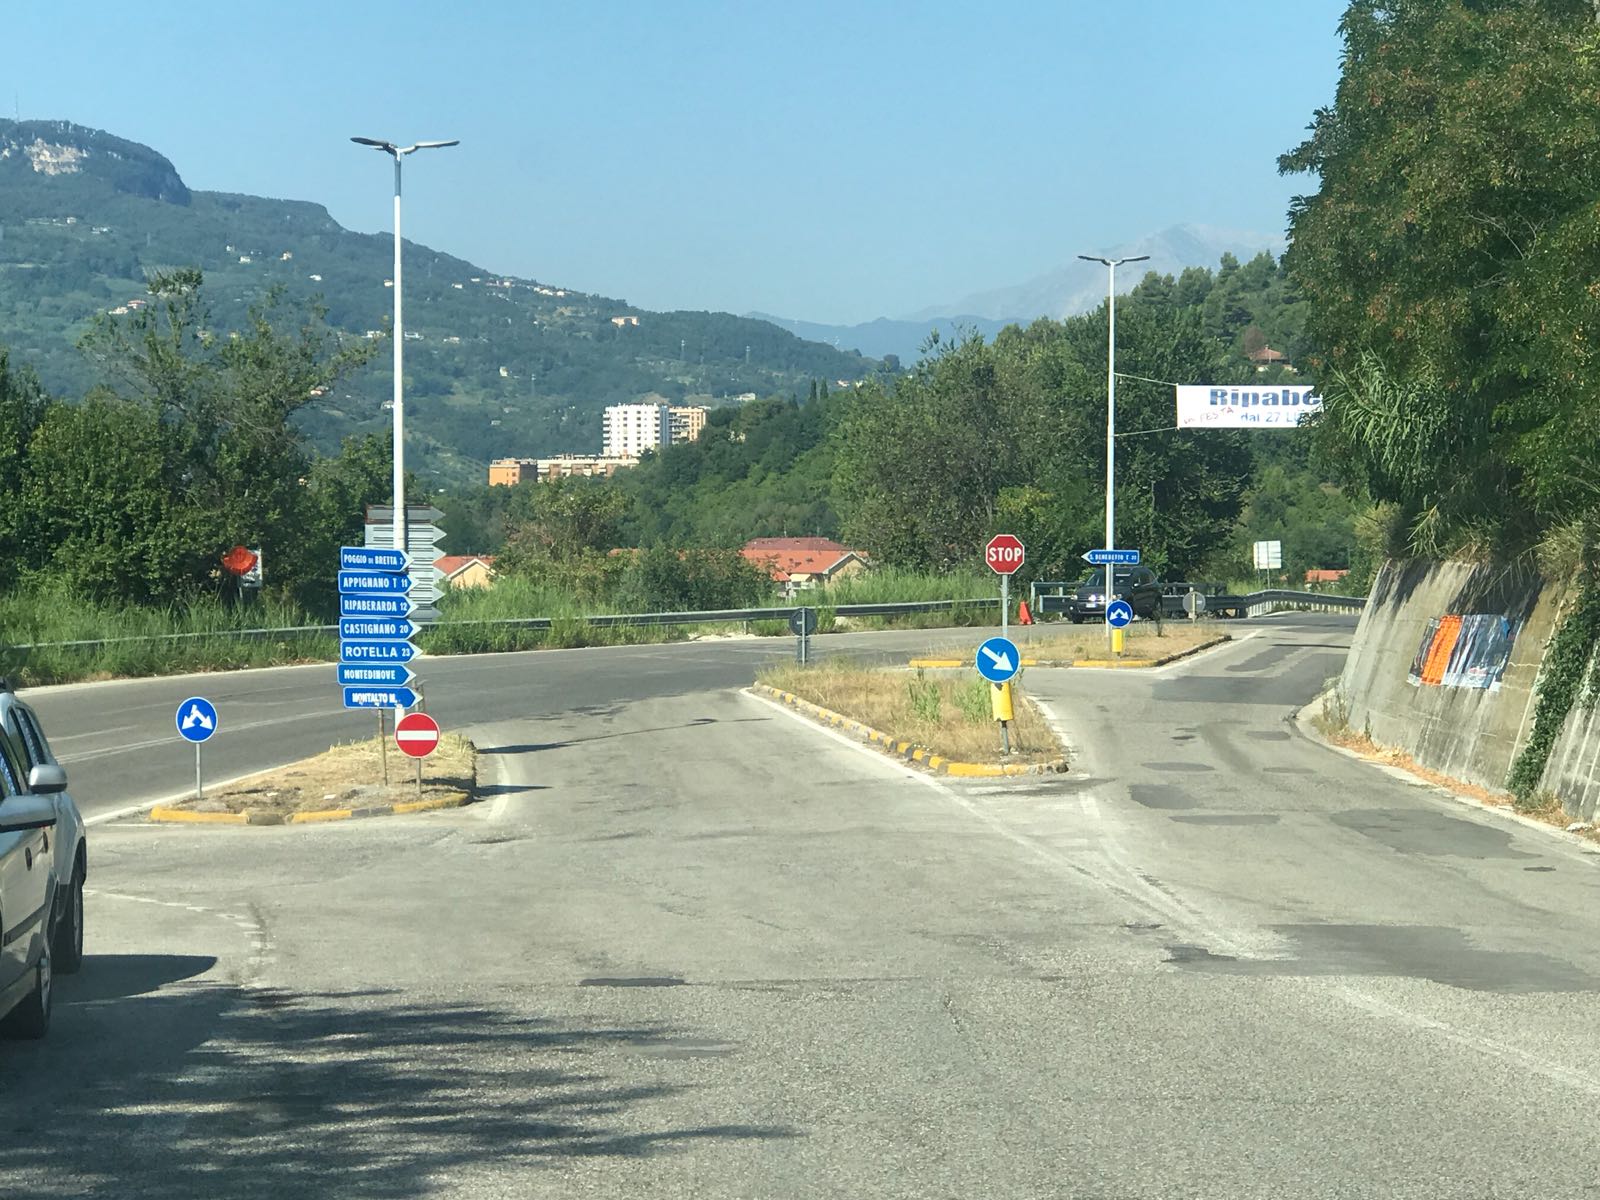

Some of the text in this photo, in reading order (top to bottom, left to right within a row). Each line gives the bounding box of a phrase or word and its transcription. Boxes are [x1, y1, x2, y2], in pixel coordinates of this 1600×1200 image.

[1210, 389, 1321, 407] Ripabe
[1265, 412, 1281, 422] 27
[344, 554, 367, 564] POGGIO
[374, 555, 397, 565] BRETTA
[989, 547, 1022, 562] STOP
[343, 577, 389, 588] APPIGNANO
[401, 578, 408, 588] 11
[344, 600, 408, 612] RIPABERARDA 12
[344, 623, 409, 634] CASTIGNANO 20
[345, 646, 411, 657] ROTELLA 23
[344, 669, 396, 680] MONTEDINOVE
[352, 692, 388, 703] MONTALTO
